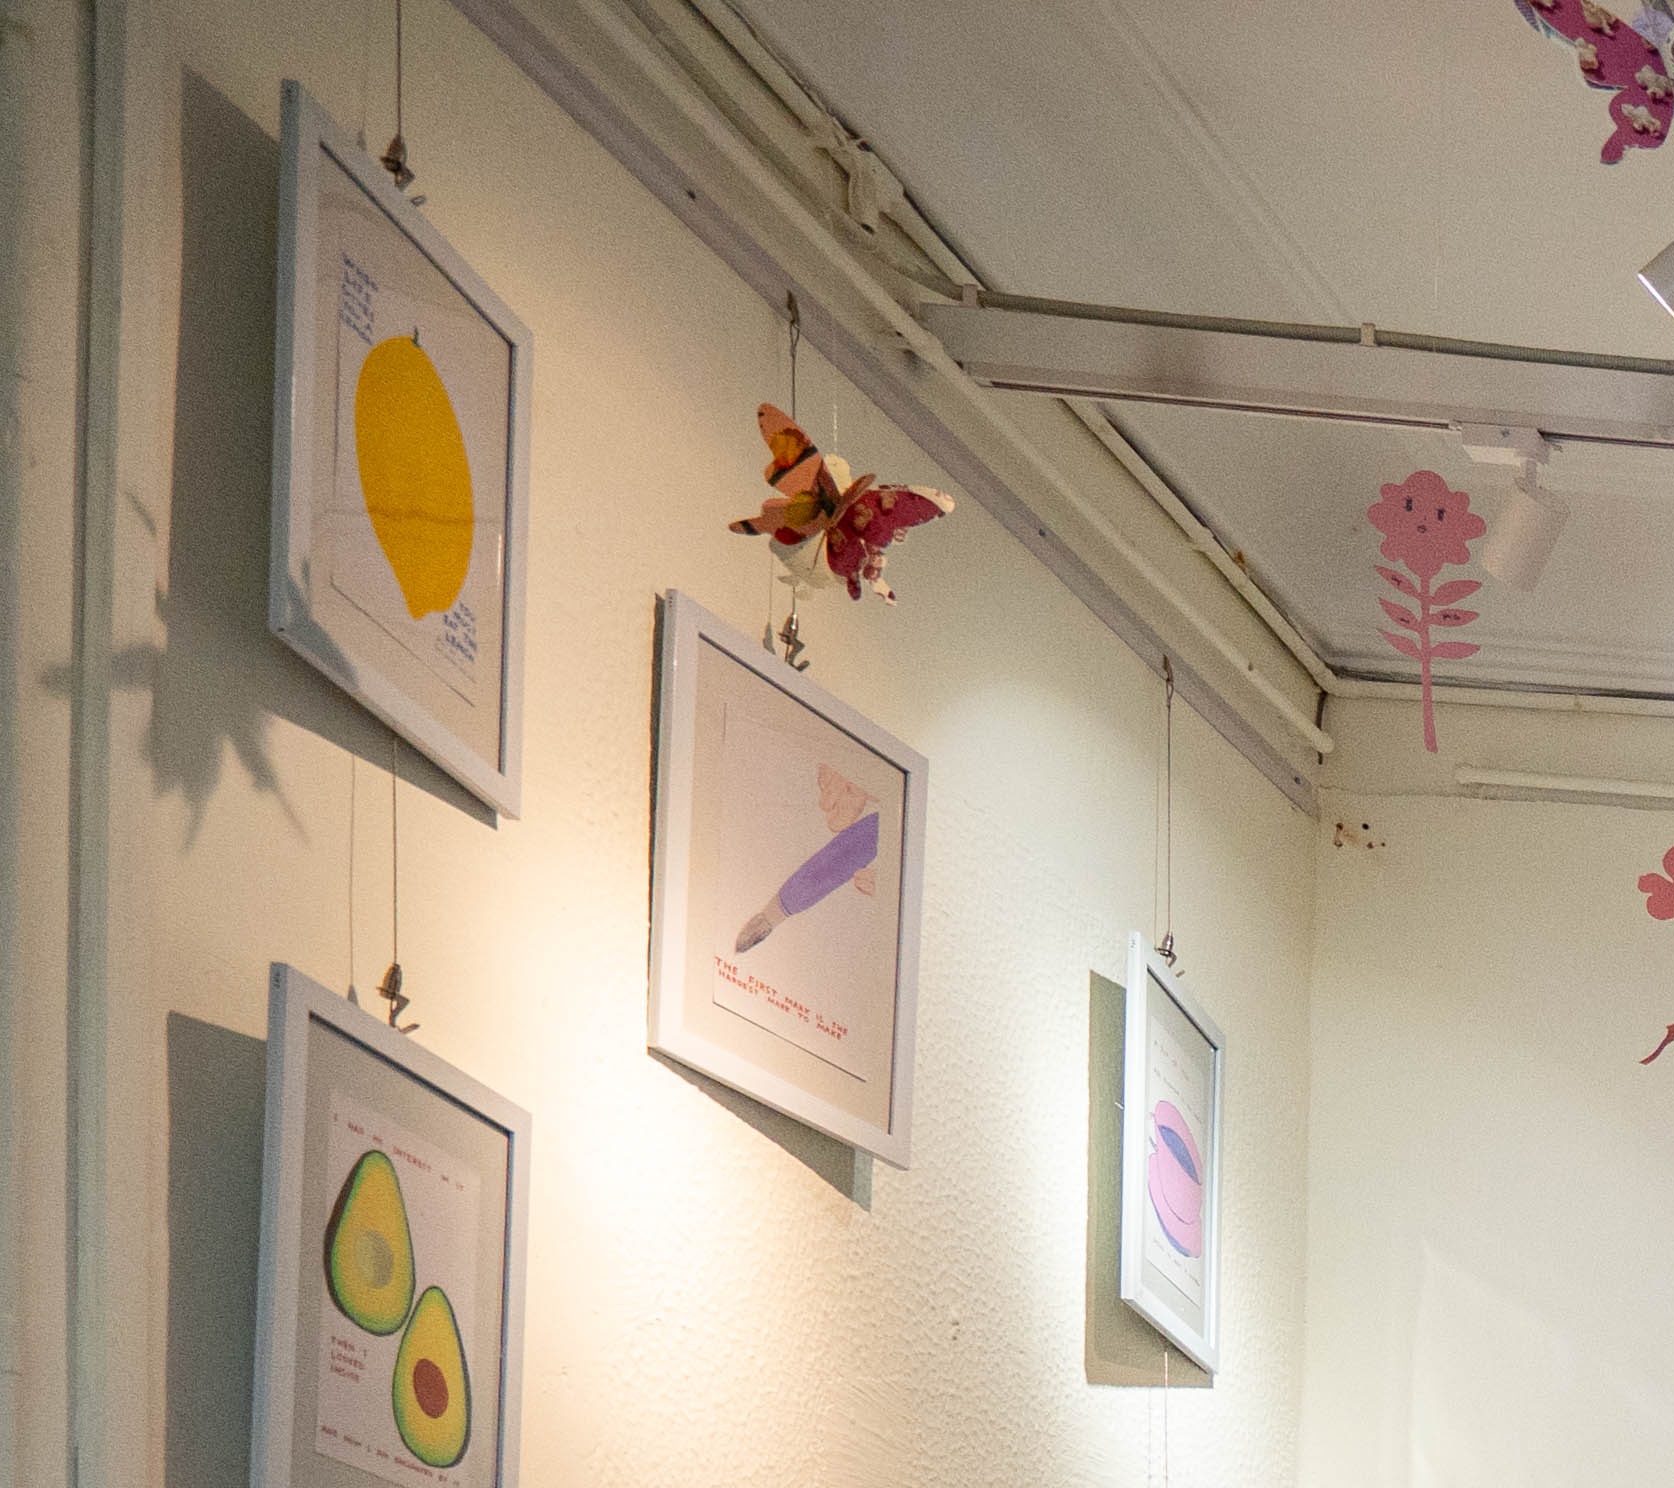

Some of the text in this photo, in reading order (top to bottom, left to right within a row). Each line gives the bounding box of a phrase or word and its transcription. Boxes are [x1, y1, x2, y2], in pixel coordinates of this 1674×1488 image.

[714, 955, 738, 976] THE
[749, 975, 777, 996] FIRST
[785, 996, 810, 1014] MARK
[718, 969, 759, 995] HARDEST
[816, 1023, 841, 1040] MAKE
